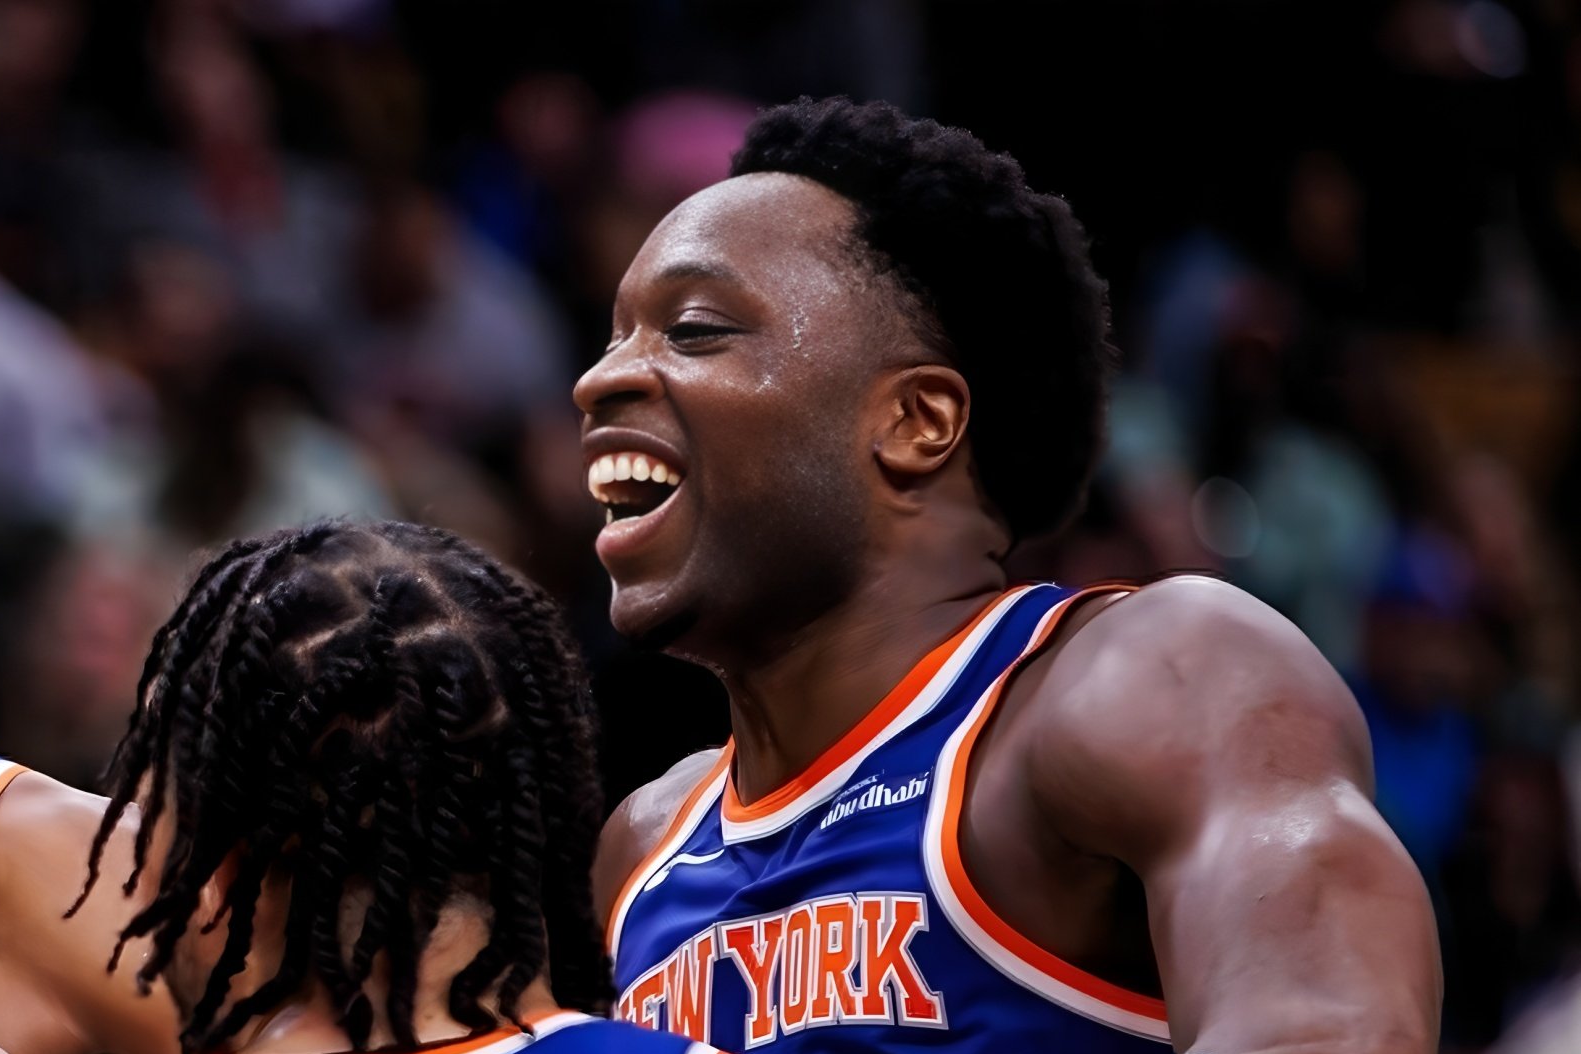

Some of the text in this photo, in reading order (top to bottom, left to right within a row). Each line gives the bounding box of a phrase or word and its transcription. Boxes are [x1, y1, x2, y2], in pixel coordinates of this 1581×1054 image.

[820, 797, 858, 830] abu
[858, 771, 930, 811] dhabi
[615, 891, 949, 1050] EW YORK
